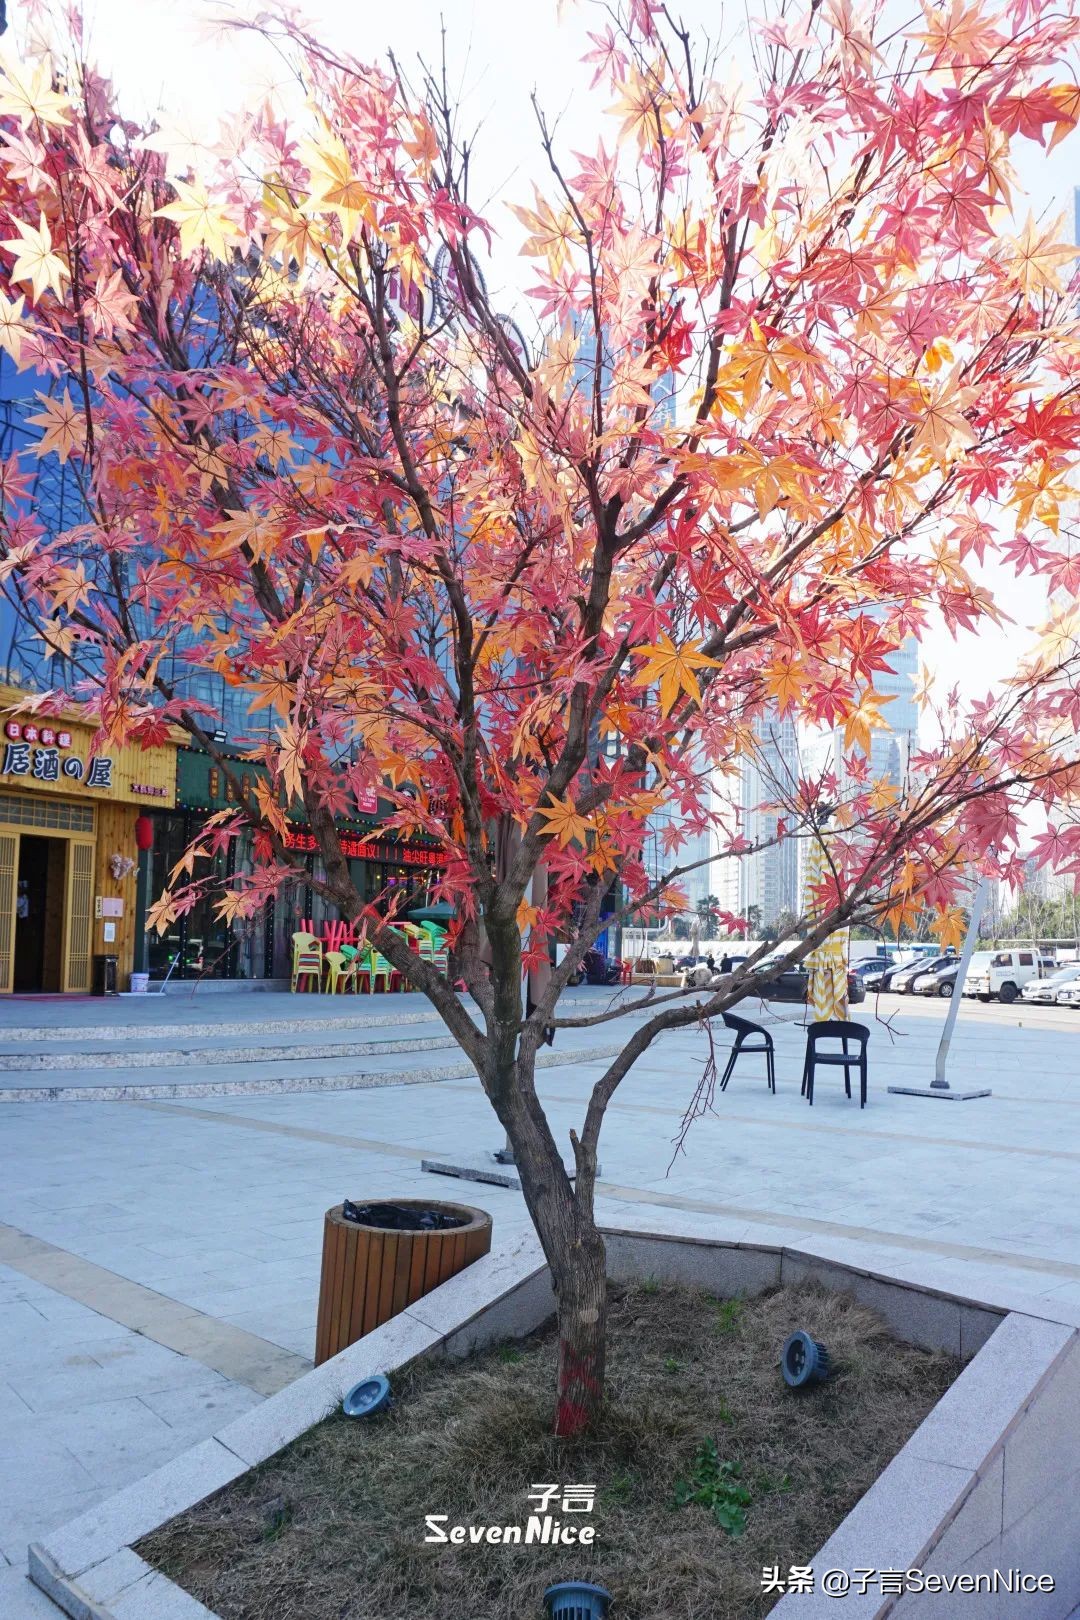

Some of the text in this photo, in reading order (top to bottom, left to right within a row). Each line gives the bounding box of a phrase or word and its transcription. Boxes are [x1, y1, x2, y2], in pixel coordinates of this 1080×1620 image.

[8, 723, 72, 748] 日本料理
[3, 743, 113, 787] 居酒の屋
